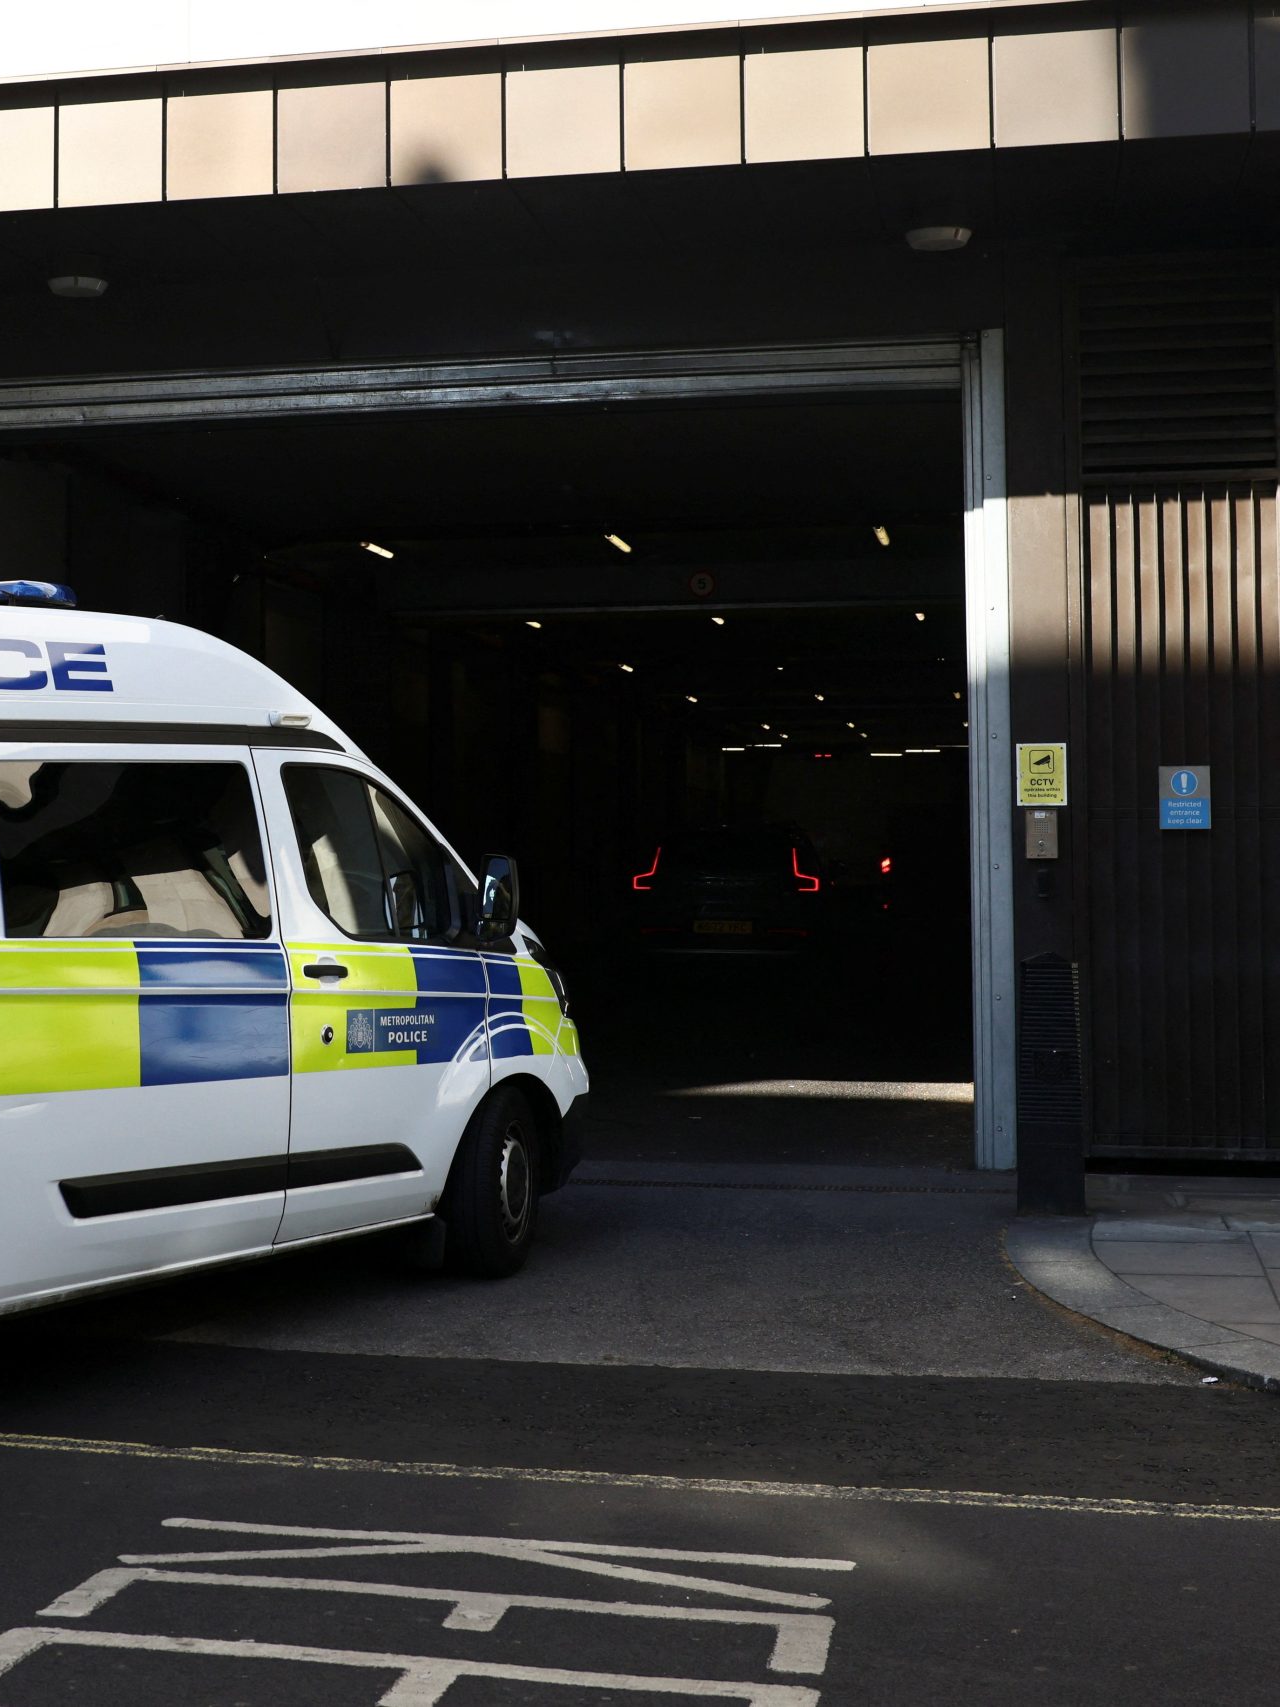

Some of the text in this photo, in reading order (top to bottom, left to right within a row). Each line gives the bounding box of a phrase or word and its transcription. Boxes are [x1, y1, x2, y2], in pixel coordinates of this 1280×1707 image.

[1030, 778, 1055, 787] CCTV
[1167, 817, 1184, 825] keep
[380, 1014, 435, 1027] METROPOLITAN
[388, 1030, 428, 1044] POLICE
